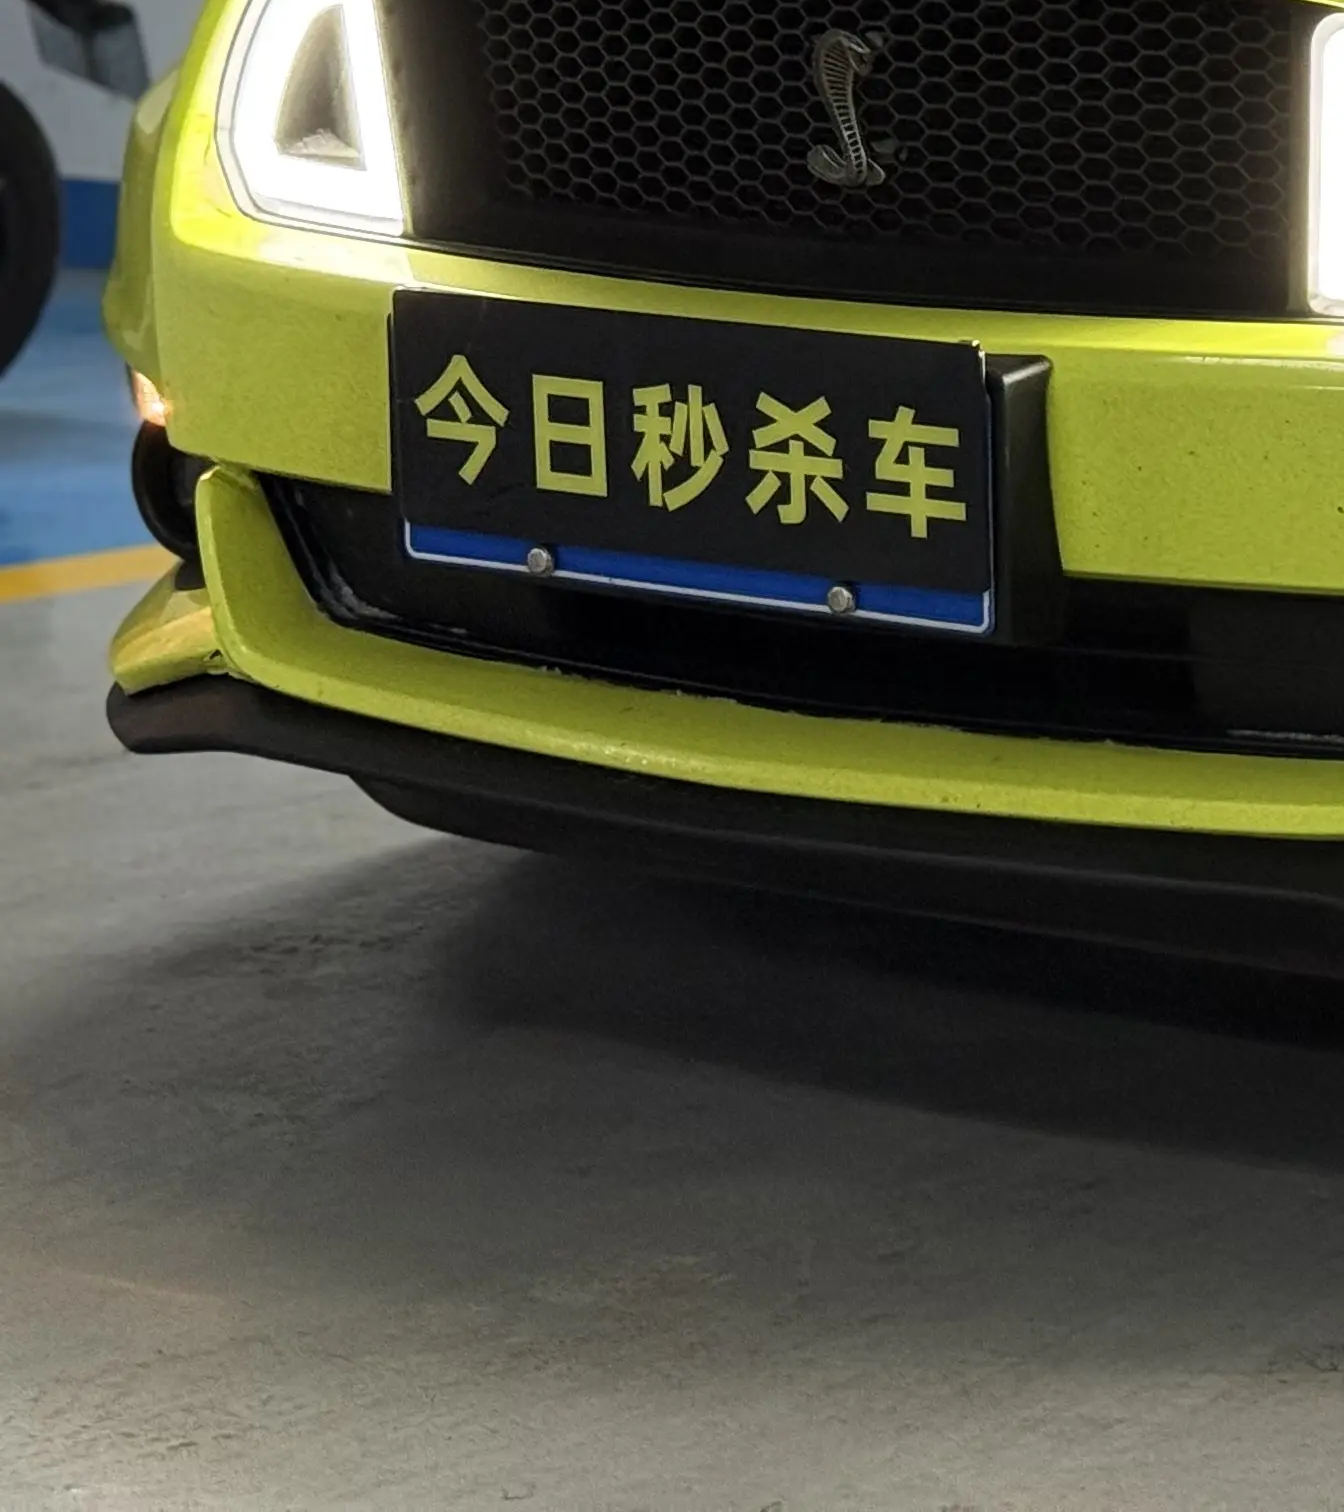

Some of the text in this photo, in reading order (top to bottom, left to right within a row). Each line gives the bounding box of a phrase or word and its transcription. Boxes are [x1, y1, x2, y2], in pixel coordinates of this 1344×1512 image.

[413, 353, 968, 540] 今日秒杀车
